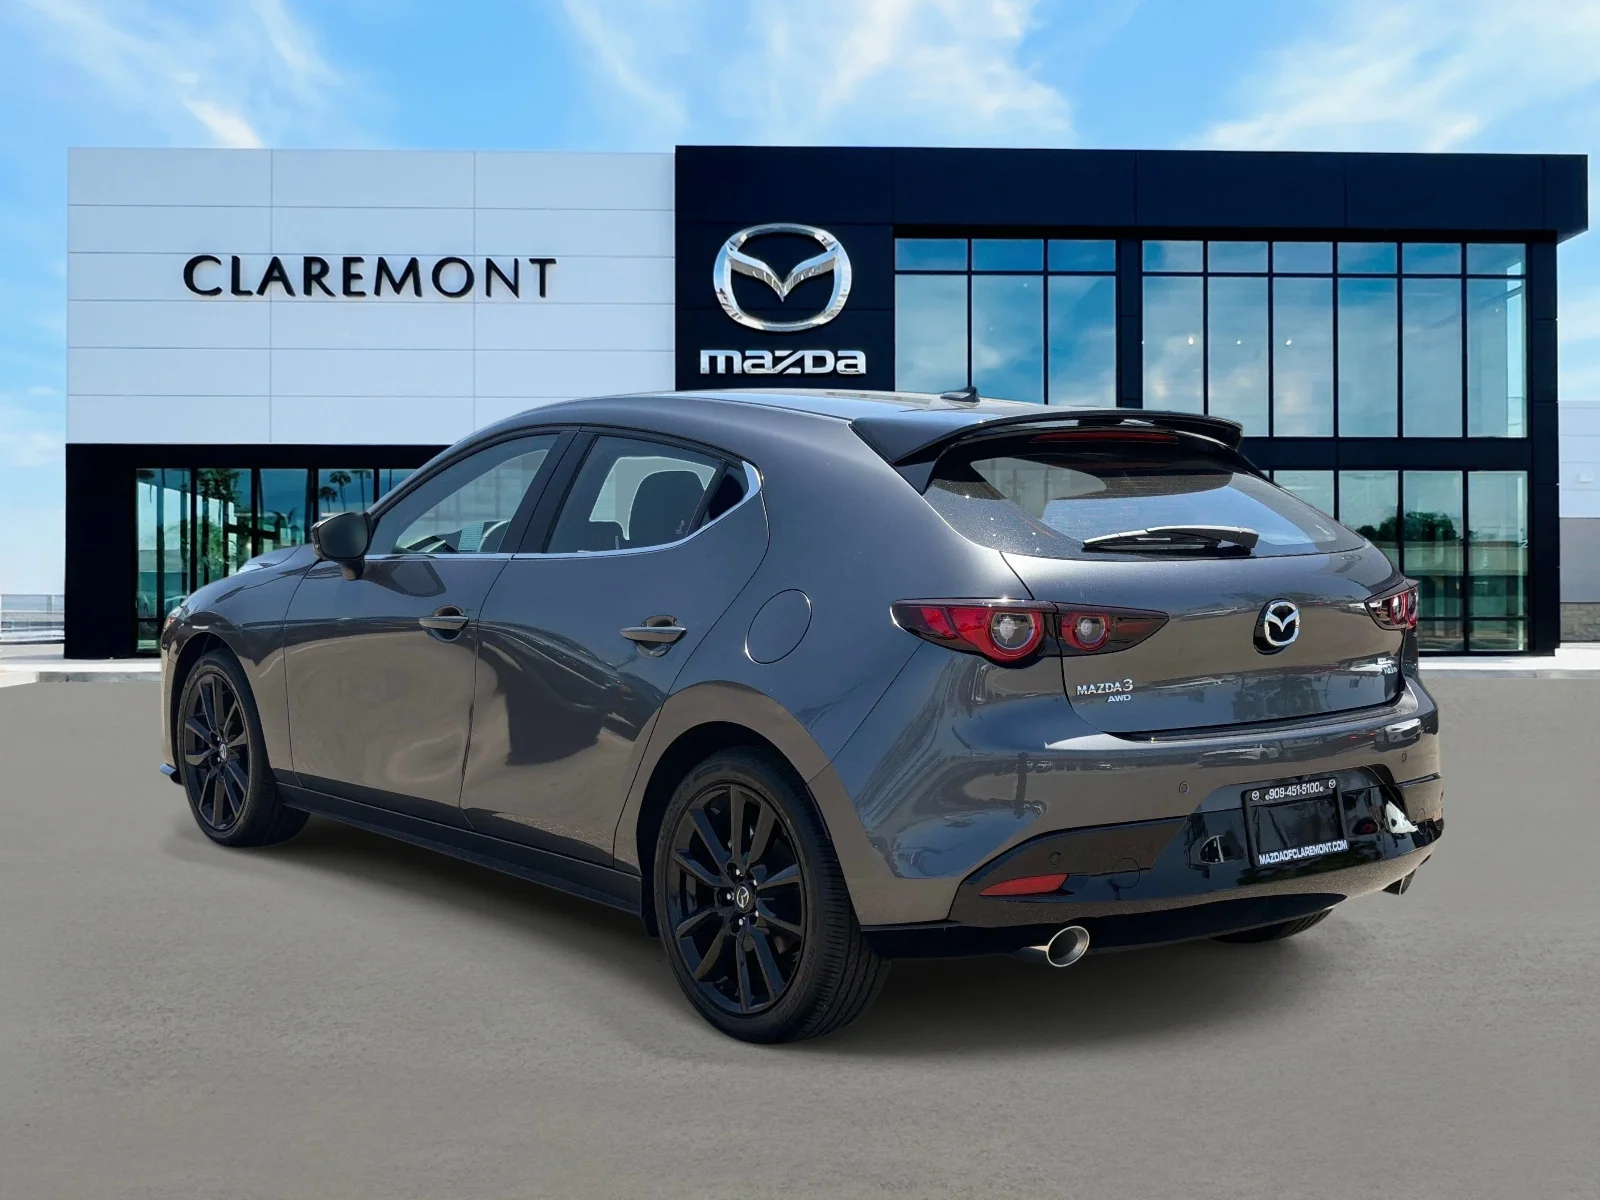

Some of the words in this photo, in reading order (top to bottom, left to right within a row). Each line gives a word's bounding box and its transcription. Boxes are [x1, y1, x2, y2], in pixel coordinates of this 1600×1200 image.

[183, 255, 558, 299] CLAREMONT
[1107, 694, 1132, 703] AWD
[1268, 781, 1320, 800] 909-451-5100
[1258, 839, 1348, 865] MAZDAOFCLAREMONT.COM
